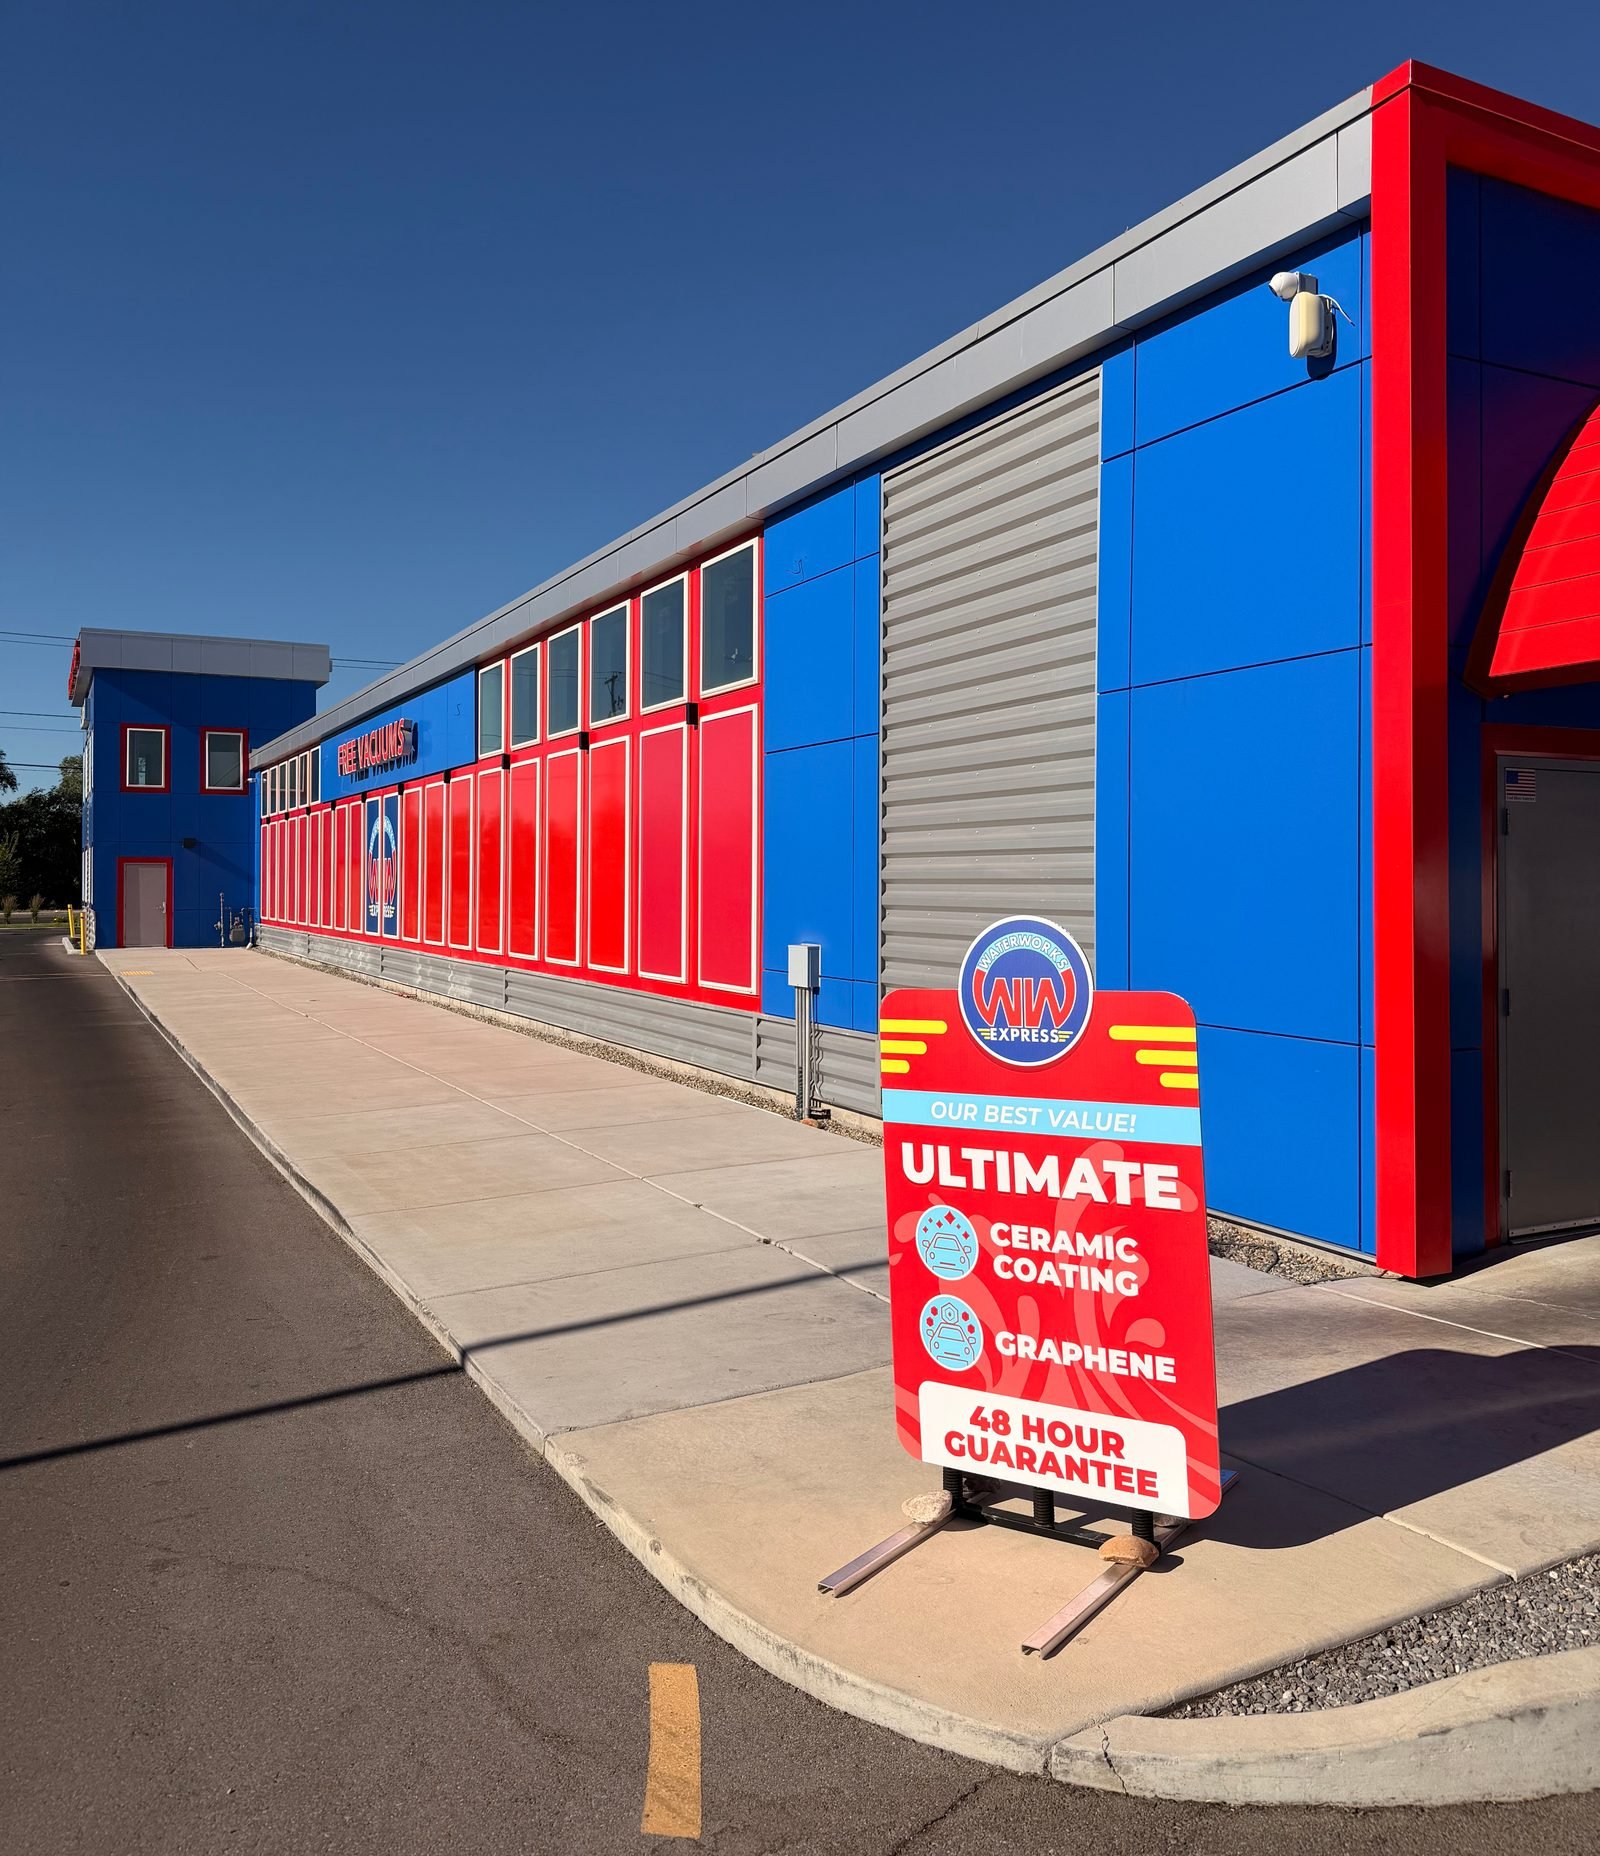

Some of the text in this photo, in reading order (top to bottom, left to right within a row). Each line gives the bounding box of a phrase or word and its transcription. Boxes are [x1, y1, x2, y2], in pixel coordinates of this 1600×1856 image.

[338, 717, 405, 776] FREE VACUUMS
[978, 933, 1068, 971] WATERWORKS
[989, 1028, 1060, 1043] EXPRESS
[931, 1101, 1136, 1133] OUR BEST VALUE!
[901, 1141, 1182, 1210] ULTIMATE
[990, 1222, 1139, 1264] CERAMIC
[993, 1254, 1139, 1297] COATING
[995, 1330, 1177, 1383] GRAPHENE
[969, 1406, 1125, 1460] 48 HOUR
[944, 1430, 1160, 1499] GUARANTEE
